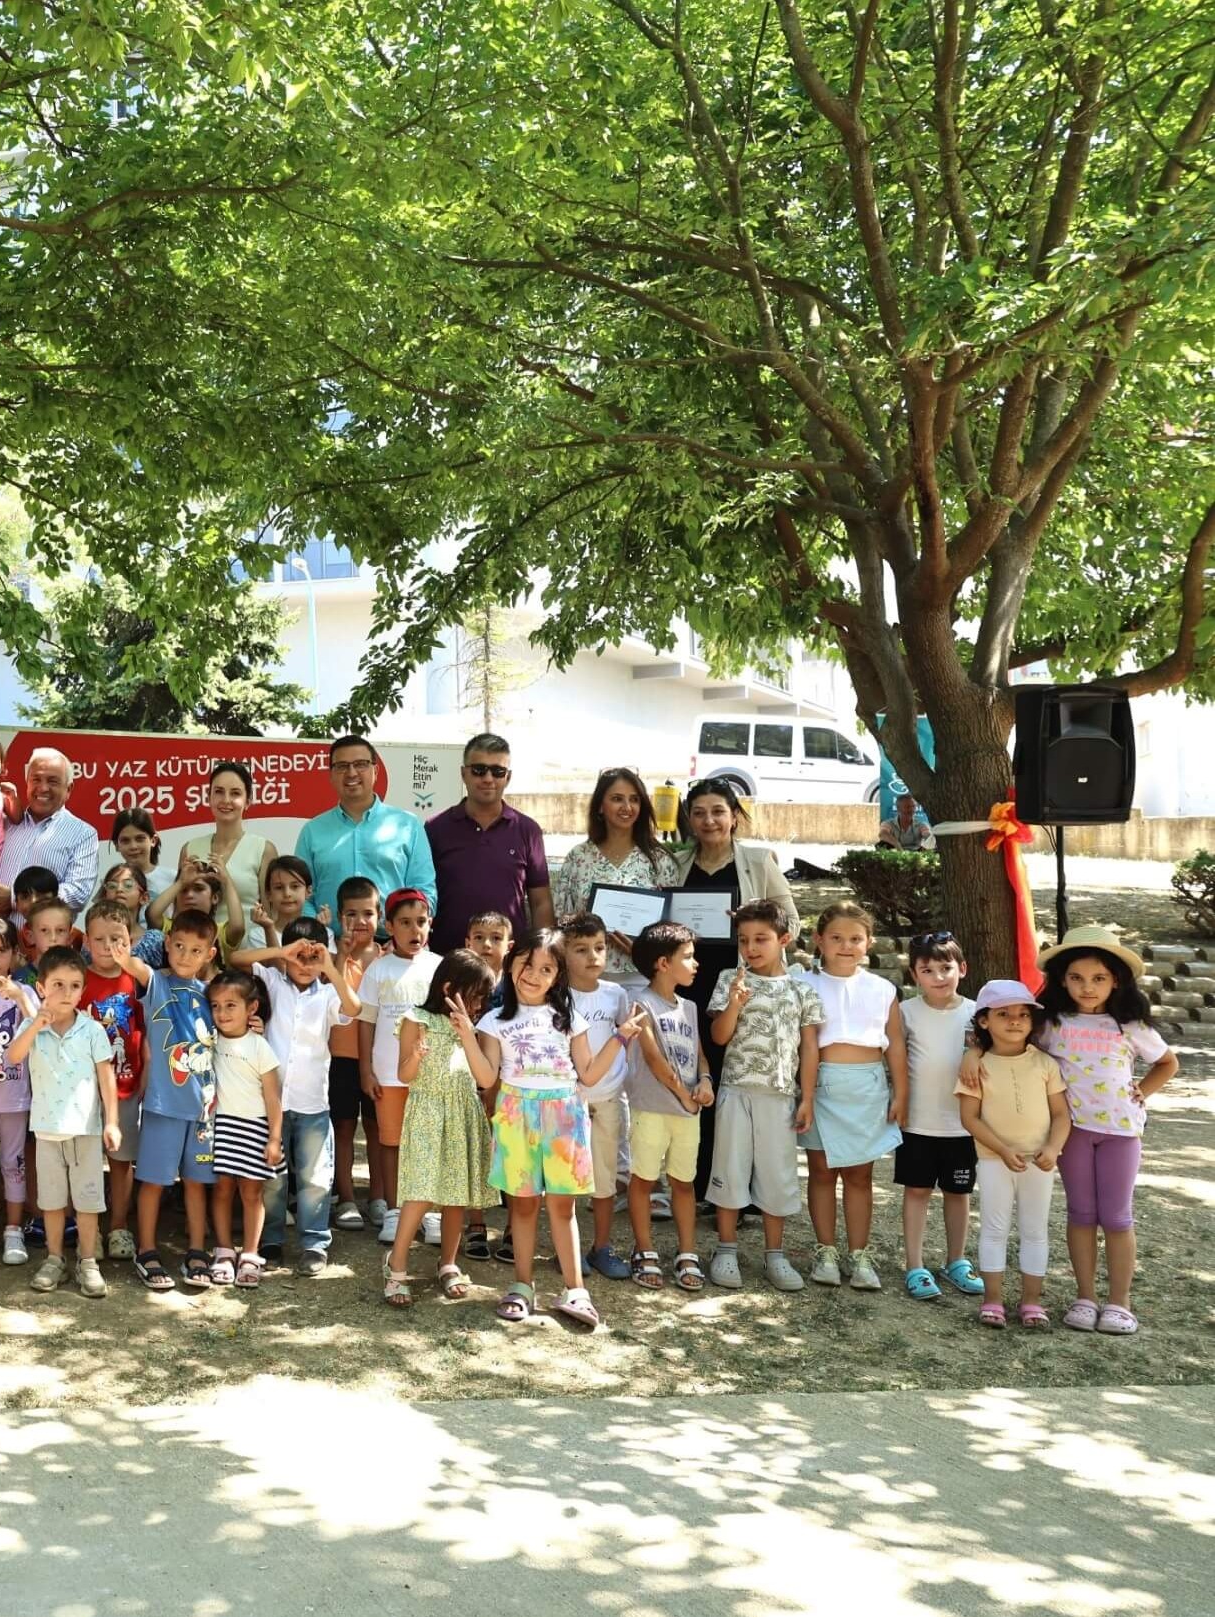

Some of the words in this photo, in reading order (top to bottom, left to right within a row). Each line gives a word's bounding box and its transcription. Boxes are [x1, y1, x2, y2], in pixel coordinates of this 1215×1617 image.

[413, 754, 428, 765] Hiç
[72, 761, 98, 780] BU
[105, 760, 148, 778] YAZ
[413, 764, 439, 773] Merak
[413, 772, 432, 781] Ettin
[413, 782, 426, 790] mi?
[99, 785, 175, 815] 2025
[184, 776, 291, 812] ŞEİĞİ
[659, 1018, 676, 1033] EW
